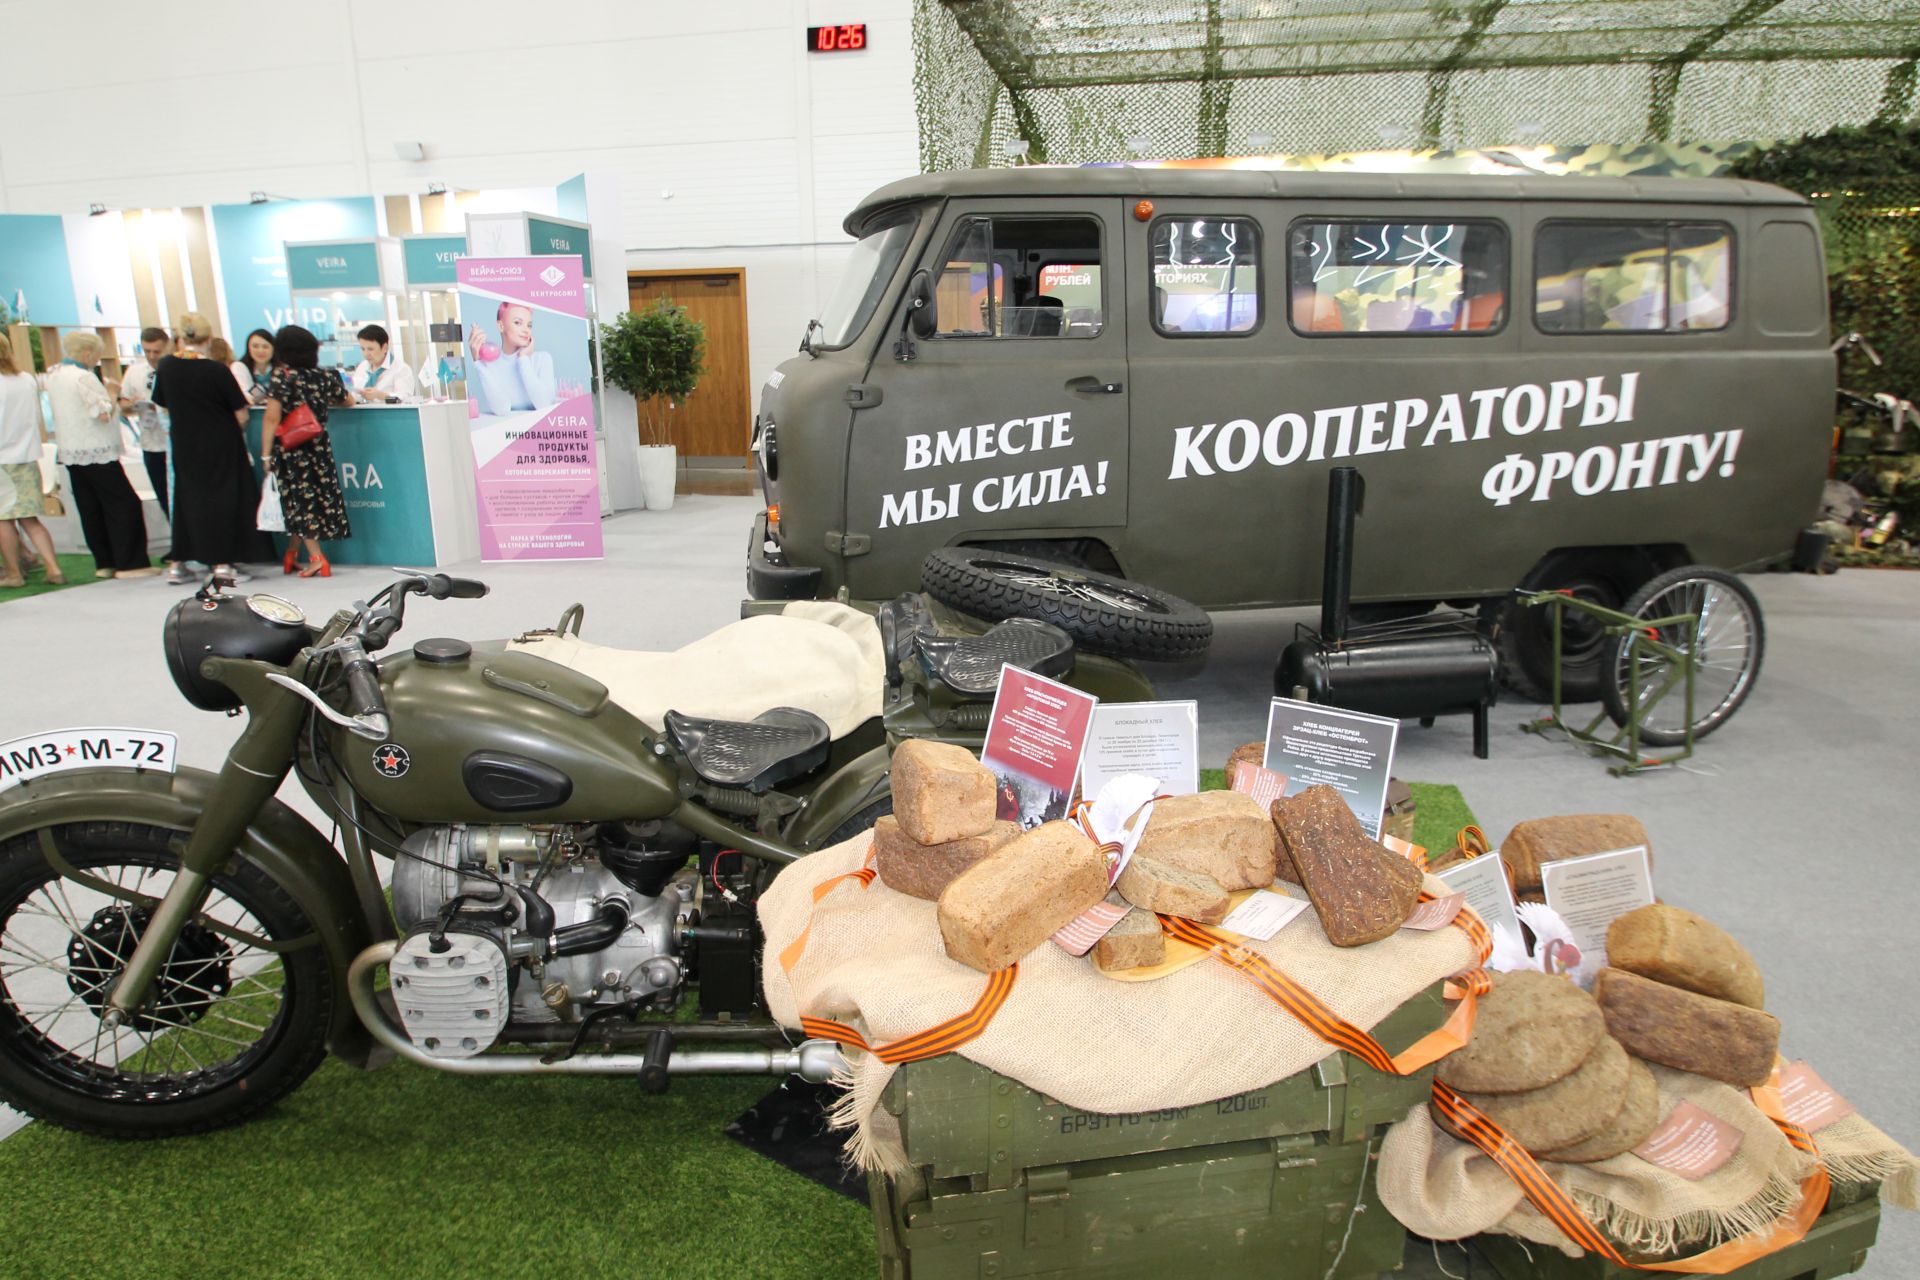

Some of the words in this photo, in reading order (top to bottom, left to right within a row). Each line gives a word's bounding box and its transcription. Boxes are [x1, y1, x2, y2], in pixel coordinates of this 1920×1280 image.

[550, 239, 570, 251] VEIRA
[316, 257, 347, 269] VEIRA
[470, 265, 522, 276] ВЕЙРА-СОЮЗ
[1045, 273, 1092, 286] РУБЛЕЙ
[1155, 272, 1209, 285] ТОРИЯХ
[548, 415, 588, 427] VEIRA
[1168, 372, 1640, 480] КООПЕРАТОРЫ
[505, 430, 588, 440] ИННОВАЦИОННЫЕ
[904, 411, 1075, 471] ВМЕСТЕ
[538, 442, 589, 452] ПРОДУКТЫ
[516, 455, 536, 465] ДЛЯ
[539, 454, 590, 465] ЗДОРОВЬЯ,
[1481, 429, 1744, 507] ФРОНТУ!
[878, 483, 962, 529] МЫ
[972, 460, 1109, 513] СИЛА!
[80, 738, 165, 764] М-72
